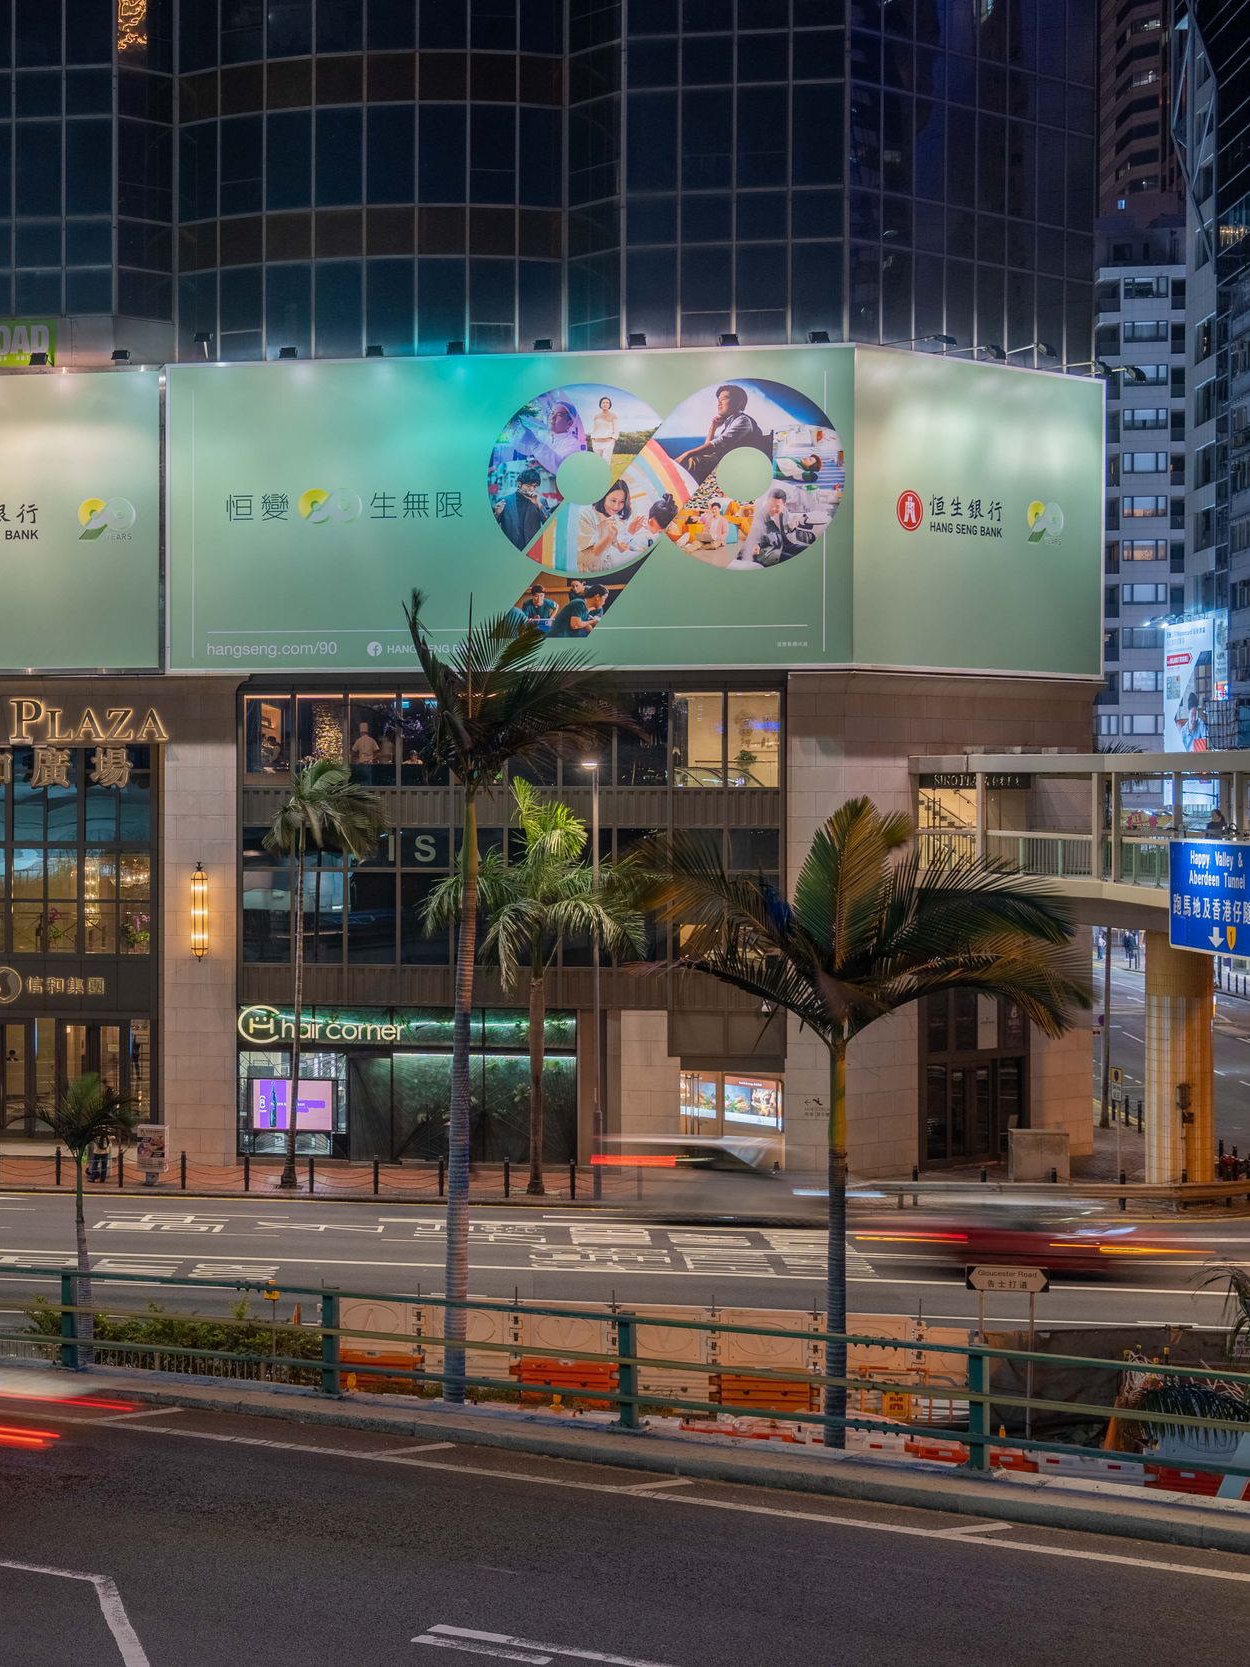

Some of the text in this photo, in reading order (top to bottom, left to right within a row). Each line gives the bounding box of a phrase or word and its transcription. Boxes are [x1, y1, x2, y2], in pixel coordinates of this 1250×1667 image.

[225, 490, 463, 522] 恒變 生無限
[929, 494, 1003, 522] 恒生銀行
[5, 529, 39, 540] BANK
[929, 521, 1003, 538] HANG SENG BANK
[207, 642, 337, 658] hangseng.com/90
[387, 644, 417, 654] HANG
[1190, 850, 1244, 871] Happy Valley &
[1189, 869, 1245, 889] Aberdeen Tunnel
[26, 975, 106, 995] 信和集團
[281, 1018, 404, 1041] hair corner
[978, 1269, 1038, 1278] Gloucester Road
[988, 1280, 1027, 1289] 告士打道
